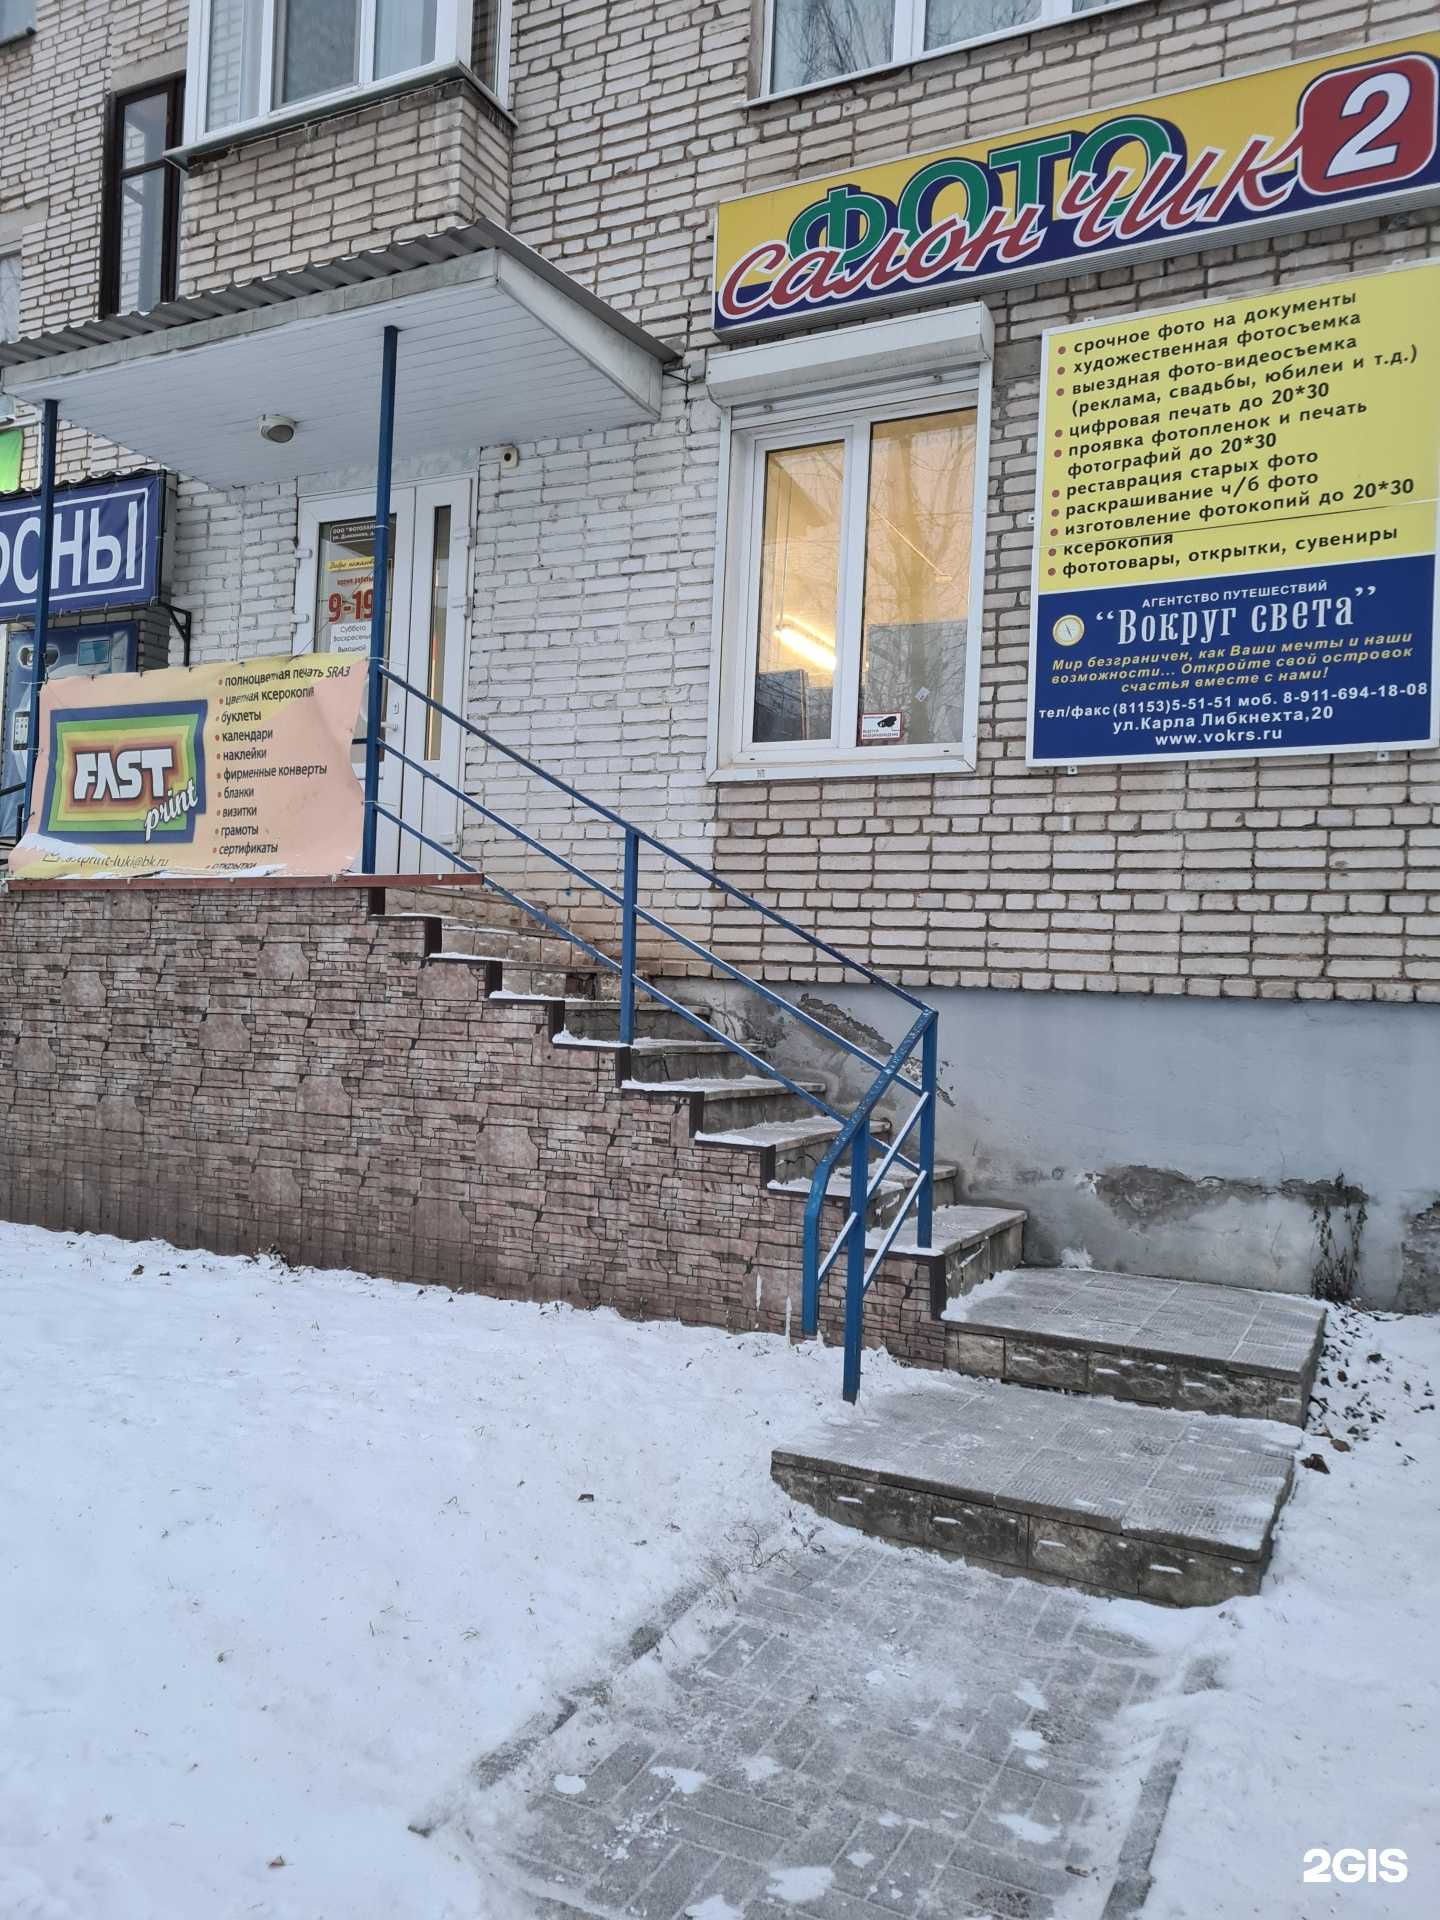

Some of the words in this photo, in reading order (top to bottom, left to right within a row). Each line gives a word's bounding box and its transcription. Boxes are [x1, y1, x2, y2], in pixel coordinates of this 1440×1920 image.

[1326, 71, 1409, 177] 2
[789, 115, 1187, 283] ФОТО
[1074, 330, 1150, 355] срочное
[1158, 320, 1205, 340] фото
[1213, 314, 1236, 328] на
[1244, 293, 1356, 325] документы
[1073, 336, 1228, 374] художественная
[1237, 313, 1361, 348] фотосъемка
[1072, 370, 1160, 395] выездная
[1168, 337, 1357, 381] фото-видеосъемка
[1072, 391, 1162, 417] (реклама,
[1169, 374, 1256, 400] свадьбы,
[1265, 361, 1343, 384] юбилеи
[1353, 357, 1364, 369] и
[1374, 344, 1418, 367] т.д.)
[1069, 412, 1160, 438] цифровая
[1168, 401, 1231, 421] печать
[1239, 396, 1263, 412] до
[1069, 436, 1144, 459] проявка
[1152, 416, 1270, 447] фотопленок
[1279, 413, 1290, 425] и
[1299, 402, 1368, 422] печать
[1066, 470, 1183, 500] реставрация
[1190, 459, 1259, 480] старых
[1267, 451, 1318, 472] фото
[1068, 446, 1181, 480] фотографий
[1189, 446, 1213, 462] до
[1065, 486, 1213, 520] раскрашивание
[1221, 476, 1259, 499] ч/б
[1268, 473, 1318, 493] фото
[1065, 510, 1191, 536] изготовление
[1199, 491, 1310, 522] фотокопий
[1319, 490, 1344, 506] до
[1062, 554, 1180, 580] фототовары,
[1188, 541, 1287, 564] открытки,
[1295, 527, 1398, 552] сувениры
[1063, 534, 1173, 556] ксерокопия
[1142, 591, 1219, 608] АГЕНТСТВО
[1224, 579, 1328, 601] ПУТЕШЕСТВИЙ
[1052, 659, 1083, 672] Мир
[1087, 652, 1194, 670] безграничен,
[1199, 649, 1225, 660] как
[1230, 644, 1276, 657] Ваши
[1281, 637, 1344, 653] мечты
[1349, 637, 1359, 648] и
[1364, 632, 1413, 646] наши
[1181, 659, 1271, 676] Откройте
[1276, 653, 1317, 668] свой
[1322, 646, 1414, 665] островок
[225, 670, 291, 687] полноцветная
[293, 668, 324, 678] печать
[325, 665, 351, 678] SRA3
[1121, 681, 1190, 693] счастья
[1194, 674, 1260, 688] вместе
[1264, 673, 1273, 683] с
[1278, 667, 1329, 682] нами!
[225, 693, 259, 706] цветная
[1238, 692, 1278, 708] моб.
[1283, 682, 1428, 704] 8-911-694-18-08
[221, 710, 262, 725] буклеты
[222, 729, 273, 743] календари
[1155, 728, 1283, 746] www.vokrs.ru
[223, 748, 267, 761] наклейки
[74, 749, 173, 801] FAST
[223, 768, 277, 785] фирменные
[278, 763, 327, 779] конверты
[224, 787, 254, 799] бланки
[144, 777, 199, 842] print
[222, 807, 257, 818] визитки
[220, 825, 258, 838] грамоты
[219, 842, 278, 856] сертификаты
